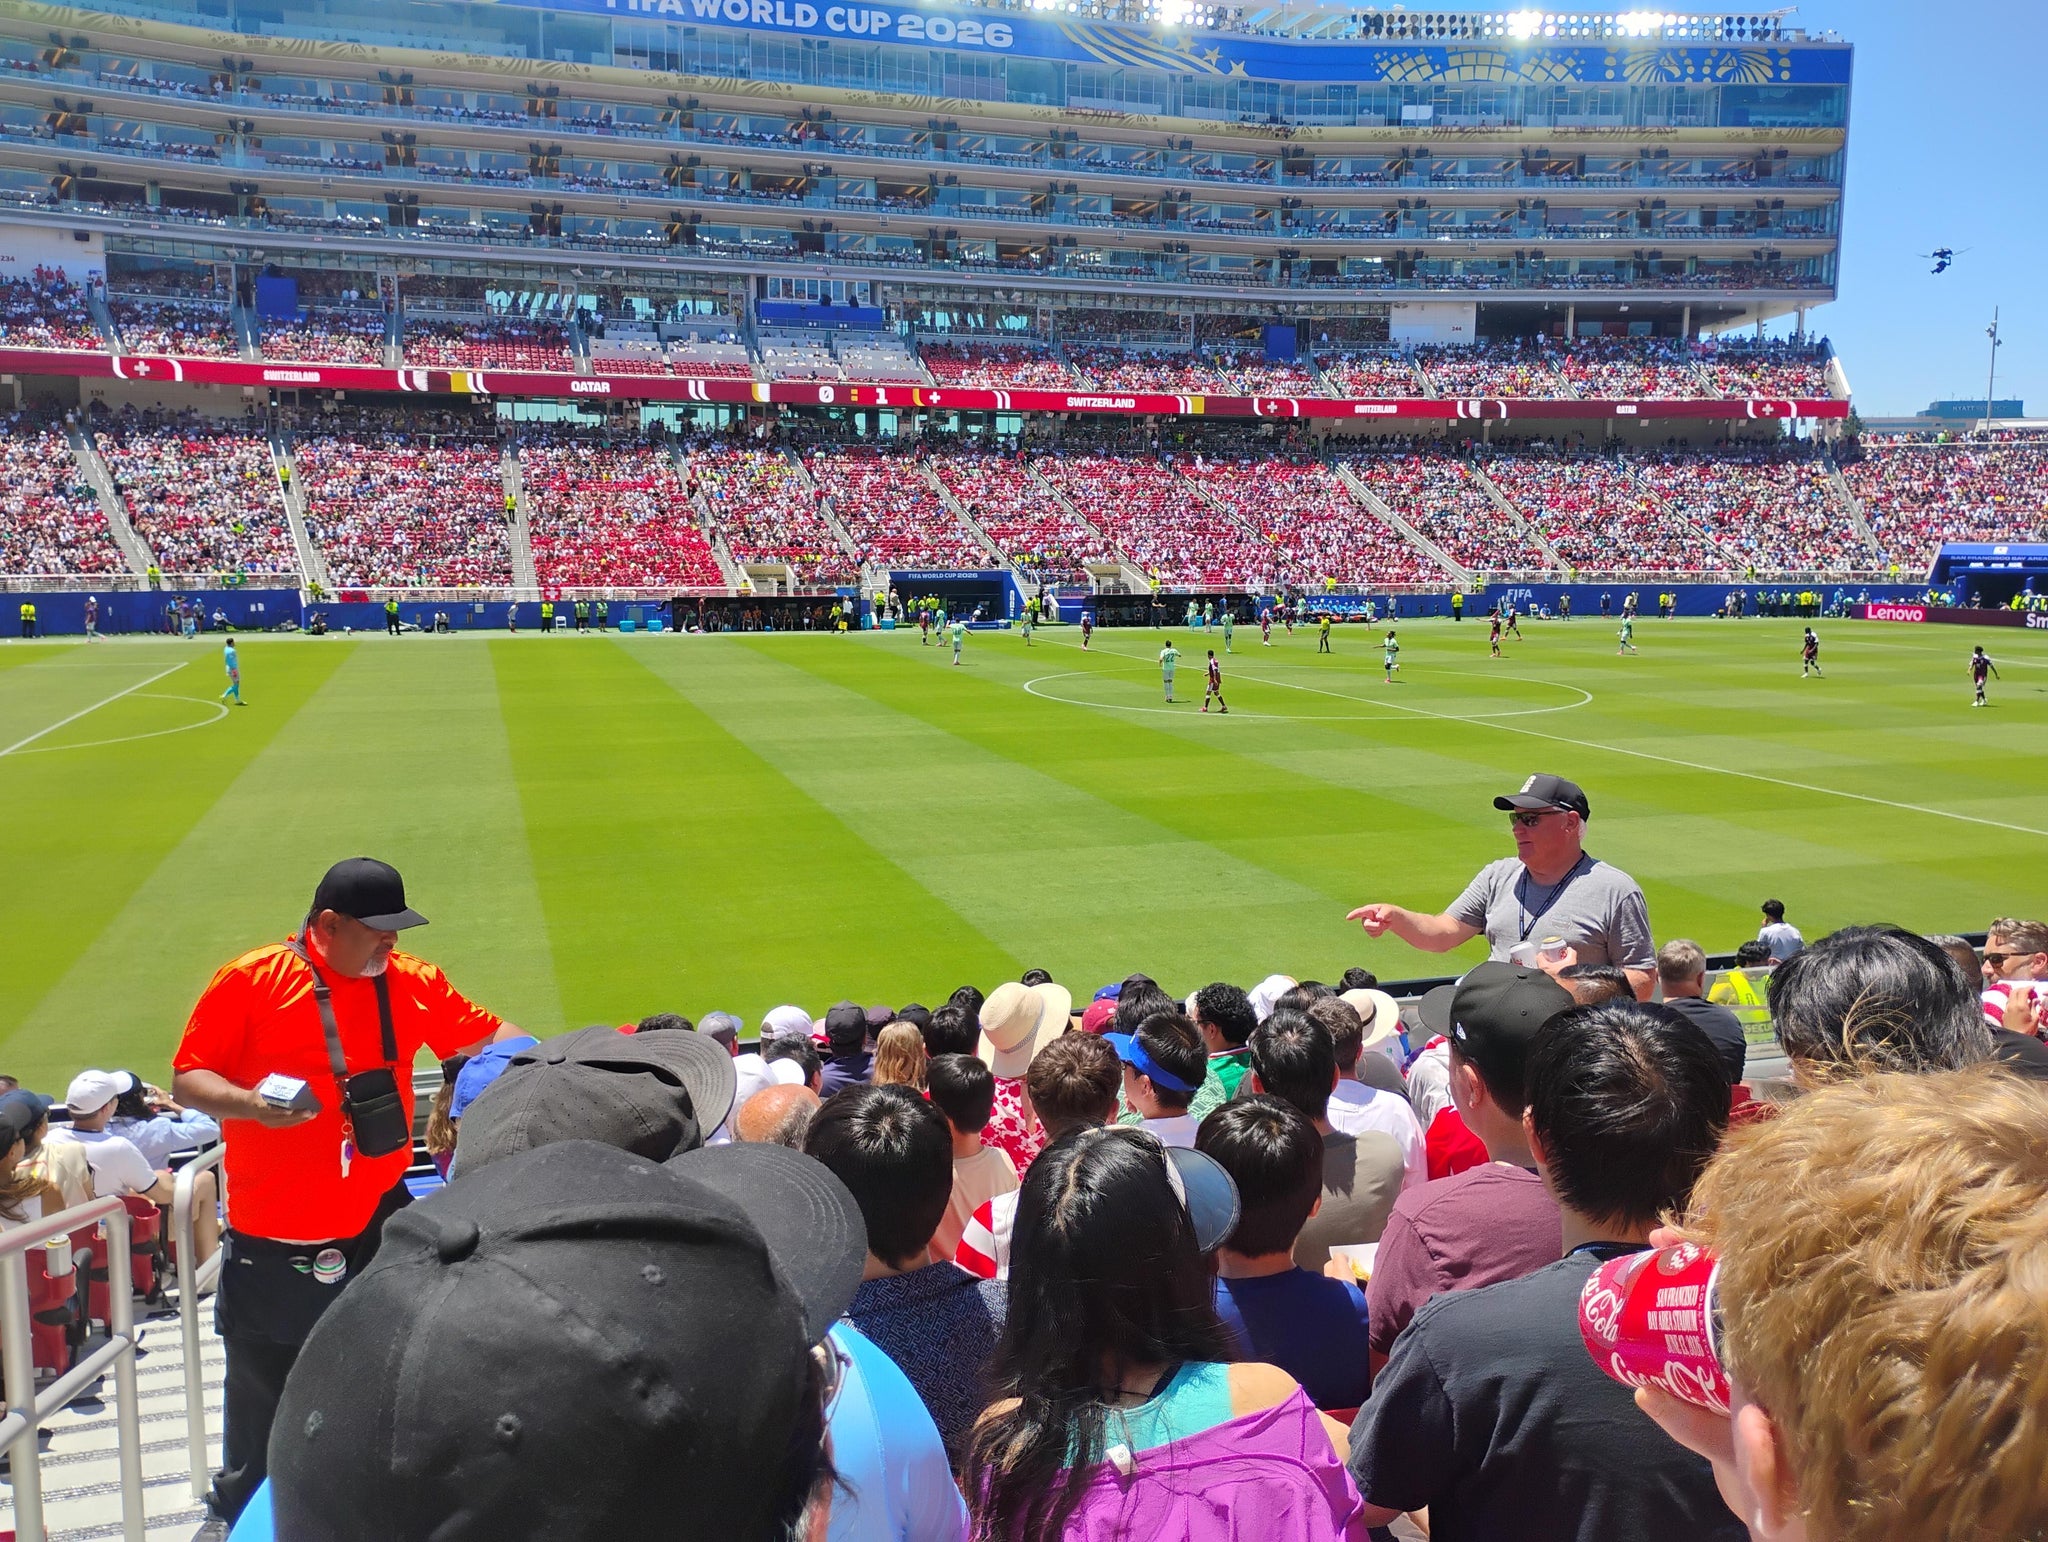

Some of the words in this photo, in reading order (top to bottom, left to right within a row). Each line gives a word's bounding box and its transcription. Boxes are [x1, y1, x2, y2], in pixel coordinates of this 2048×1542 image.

[693, 0, 818, 28] WORLD
[825, 6, 891, 36] CUP
[898, 14, 1013, 48] 2026
[571, 380, 610, 393] QATAR
[819, 386, 834, 403] 0
[876, 388, 888, 404] 1
[1067, 397, 1135, 408] SWITZERLAND
[1507, 589, 1533, 599] FIFA
[1867, 605, 1923, 621] Lenovo
[1165, 653, 1175, 662] 22
[1743, 1023, 1773, 1034] SECU
